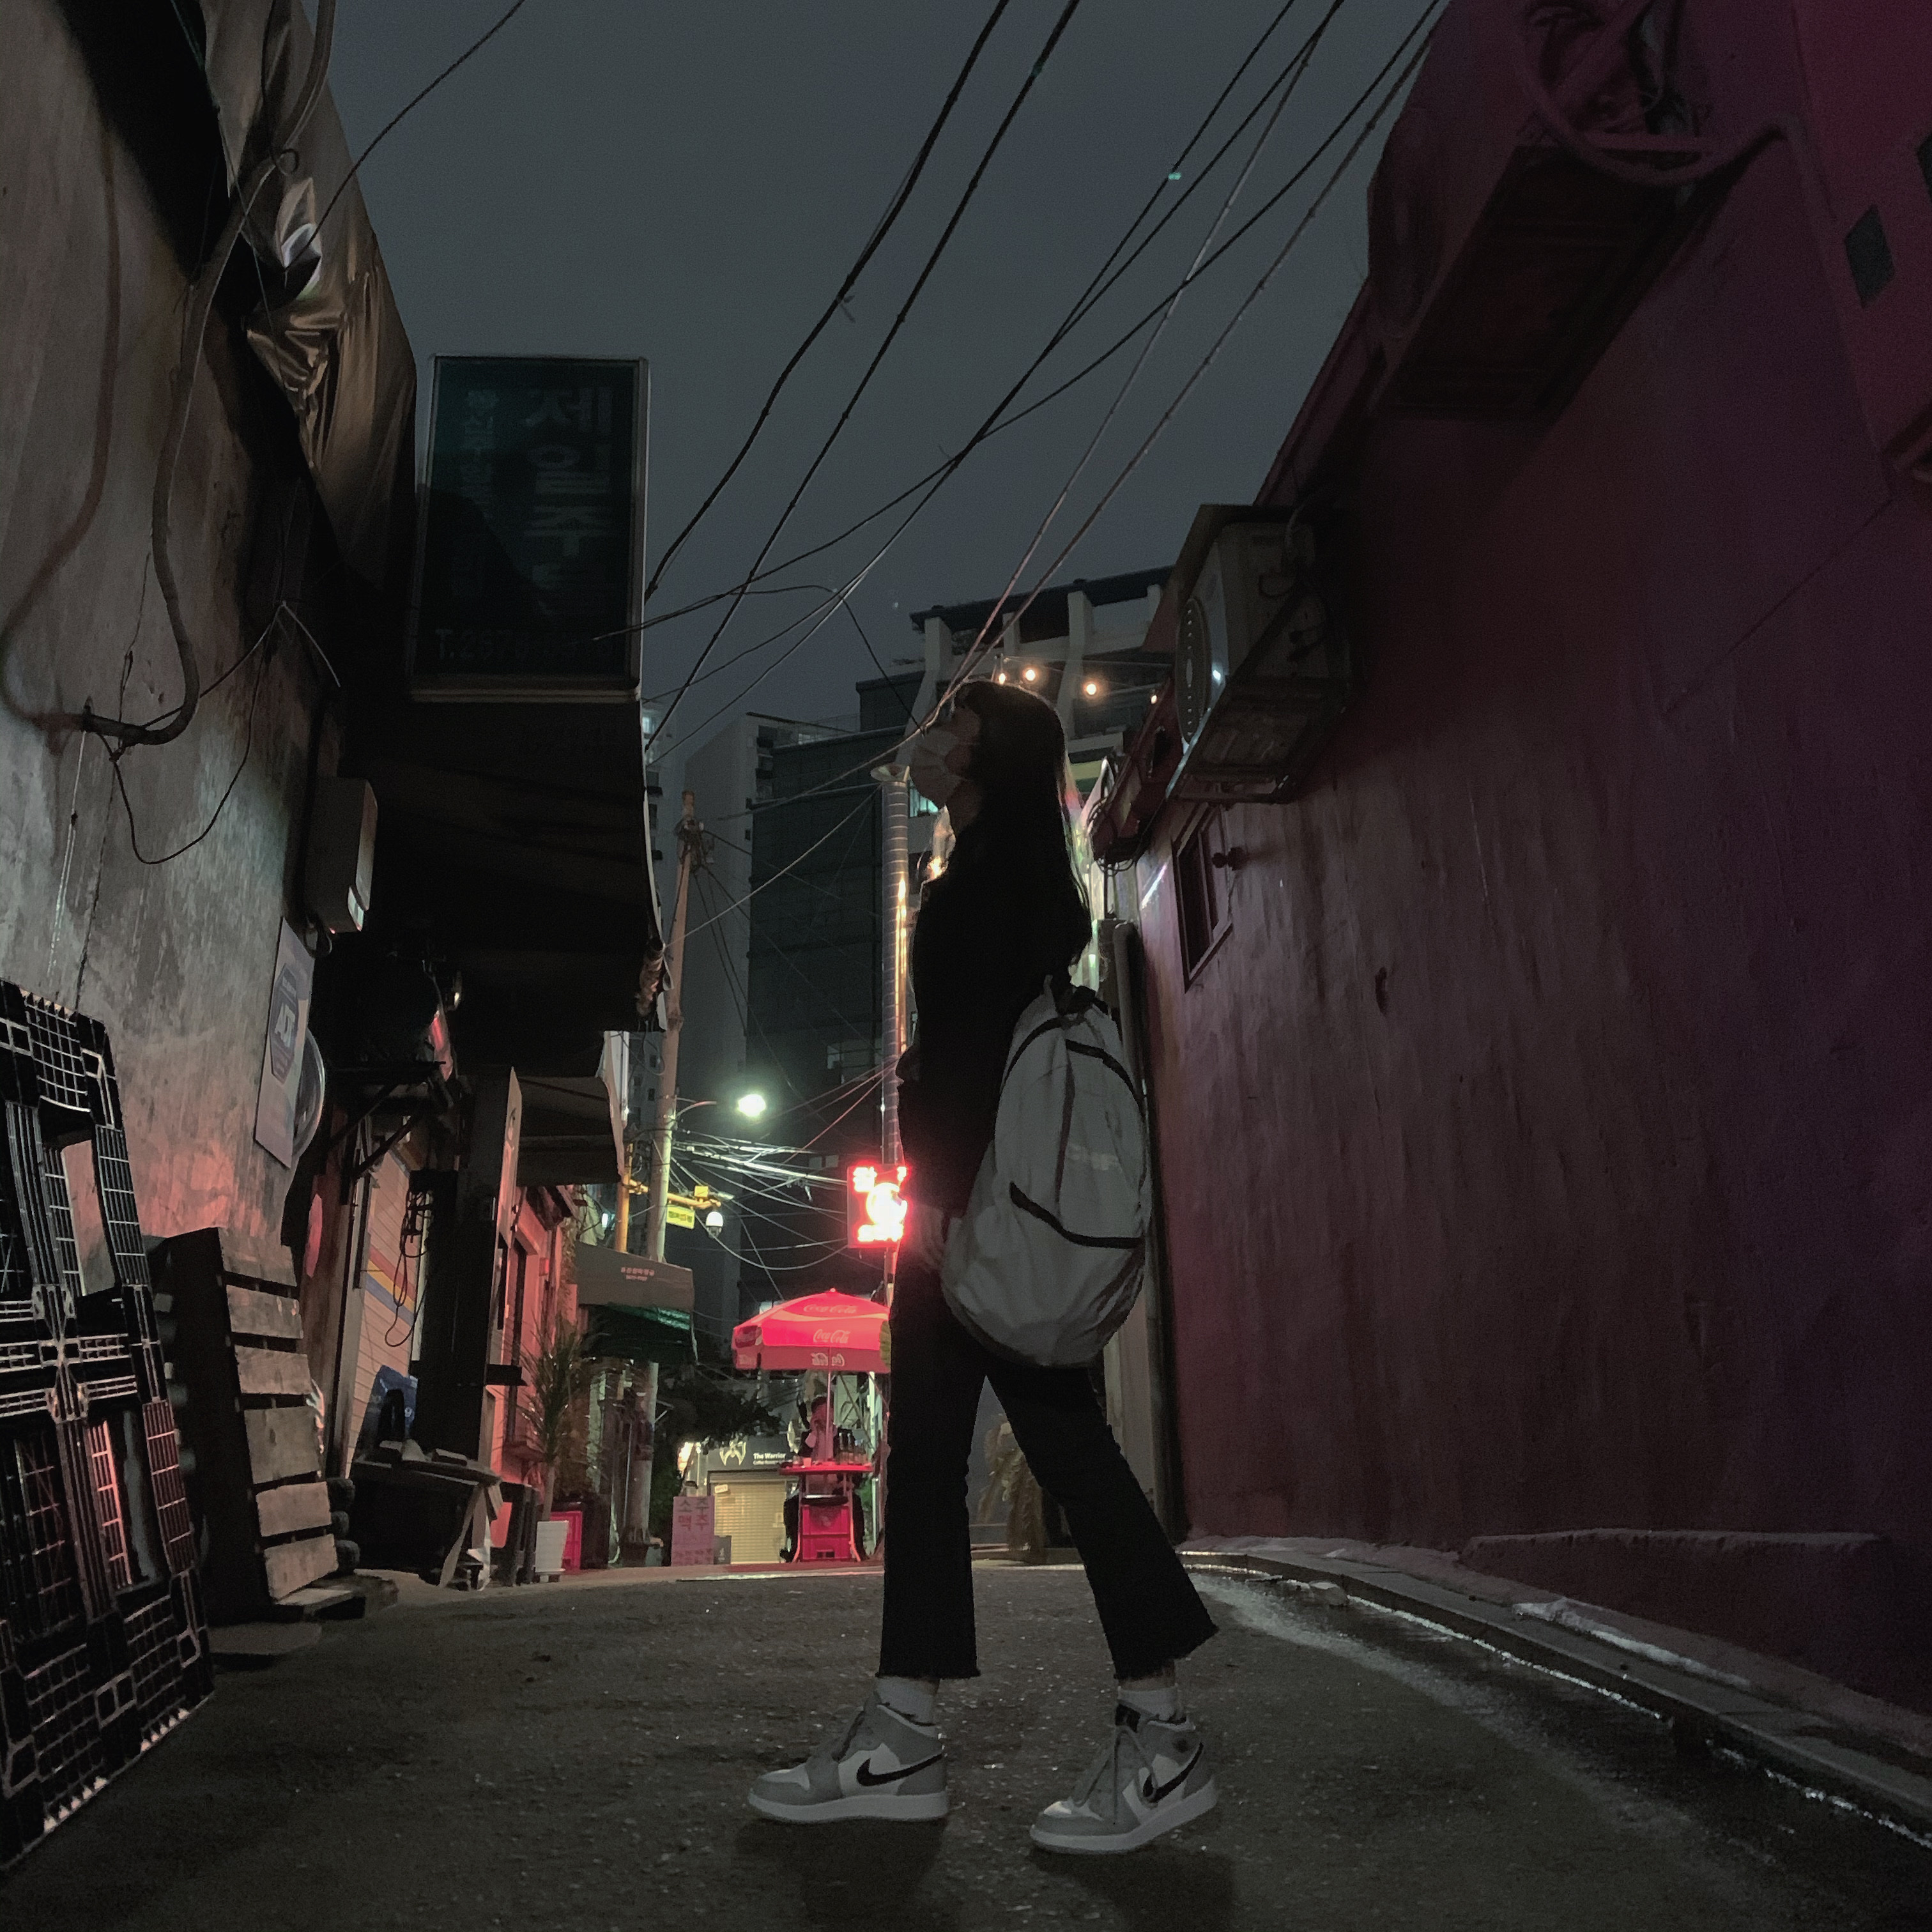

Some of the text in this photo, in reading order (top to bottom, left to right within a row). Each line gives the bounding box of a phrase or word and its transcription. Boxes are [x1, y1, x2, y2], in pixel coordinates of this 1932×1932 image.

[275, 1004, 296, 1048] ADT
[678, 1498, 709, 1515] 소주
[678, 1515, 709, 1531] 맥주
